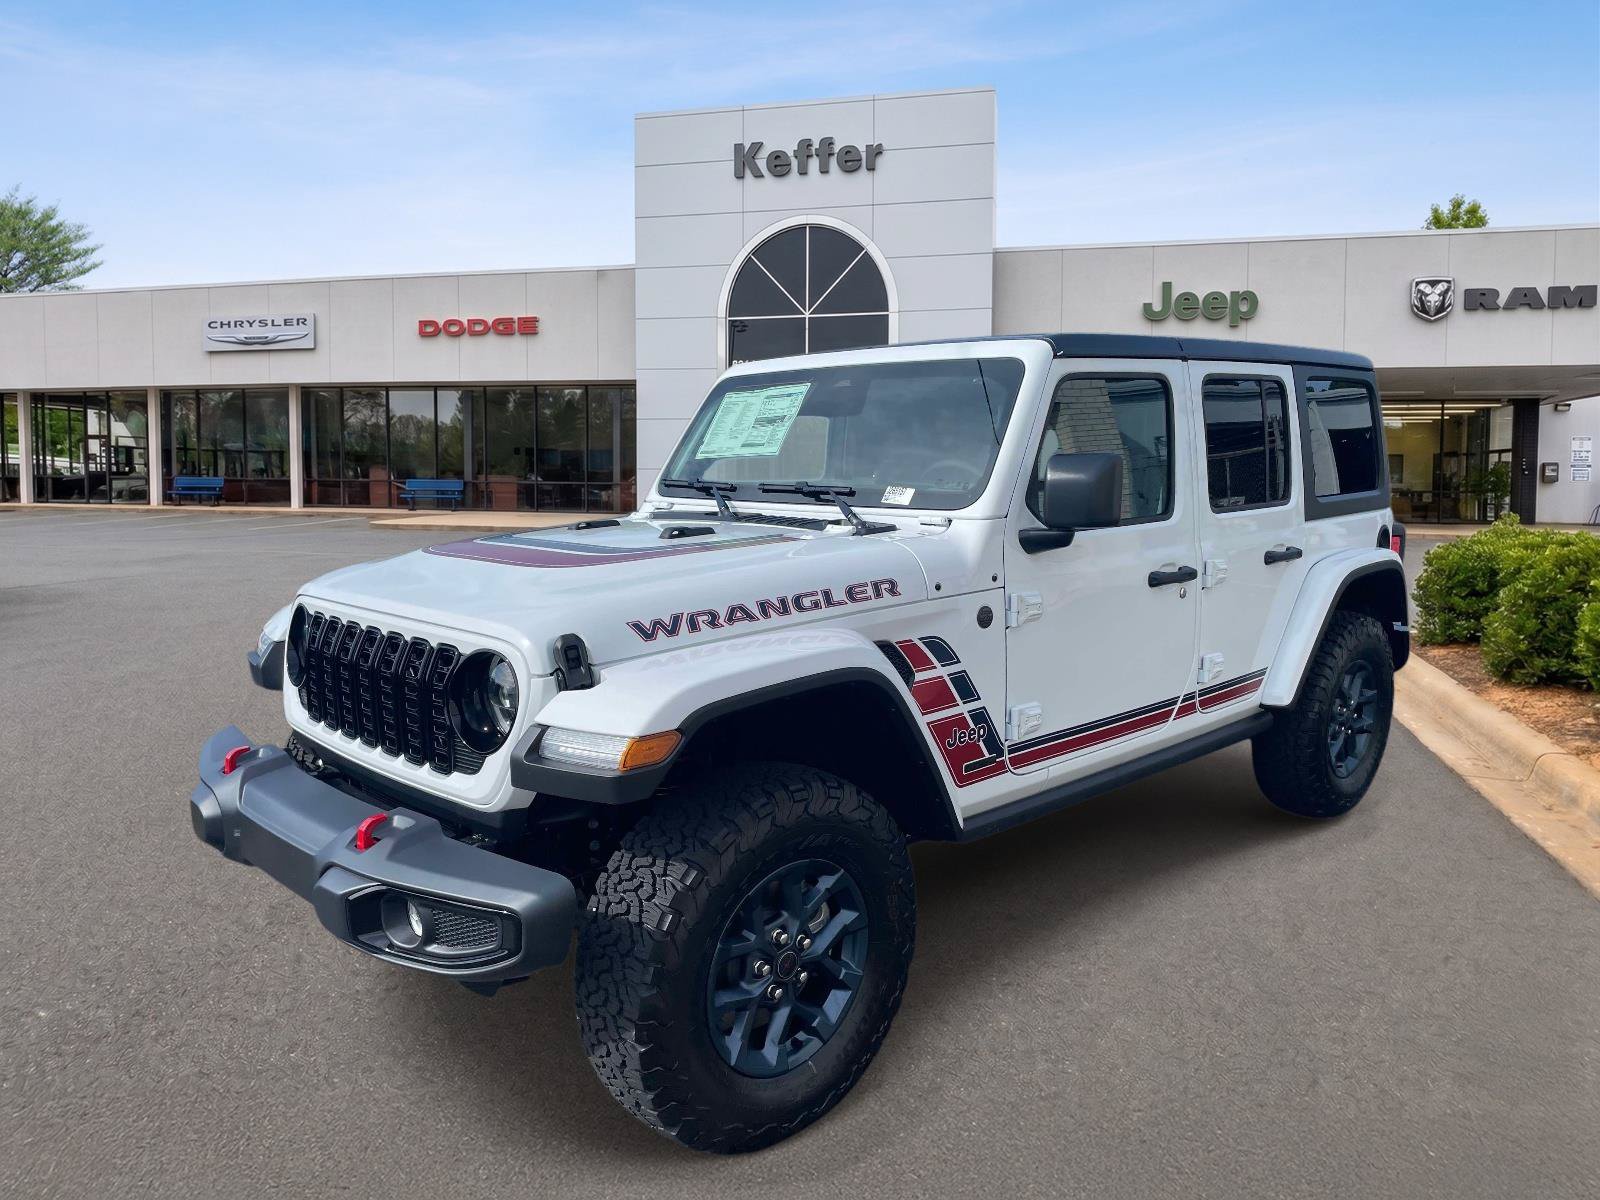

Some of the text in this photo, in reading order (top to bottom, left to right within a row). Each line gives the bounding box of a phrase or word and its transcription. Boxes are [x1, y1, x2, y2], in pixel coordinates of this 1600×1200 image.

[734, 137, 883, 179] Keffer
[1143, 281, 1259, 327] Jeep
[1464, 285, 1598, 310] RAM
[207, 317, 308, 329] CHRYSLER
[418, 316, 539, 337] DODGE
[626, 577, 902, 642] WRANGLER
[946, 723, 988, 750] Jeep
